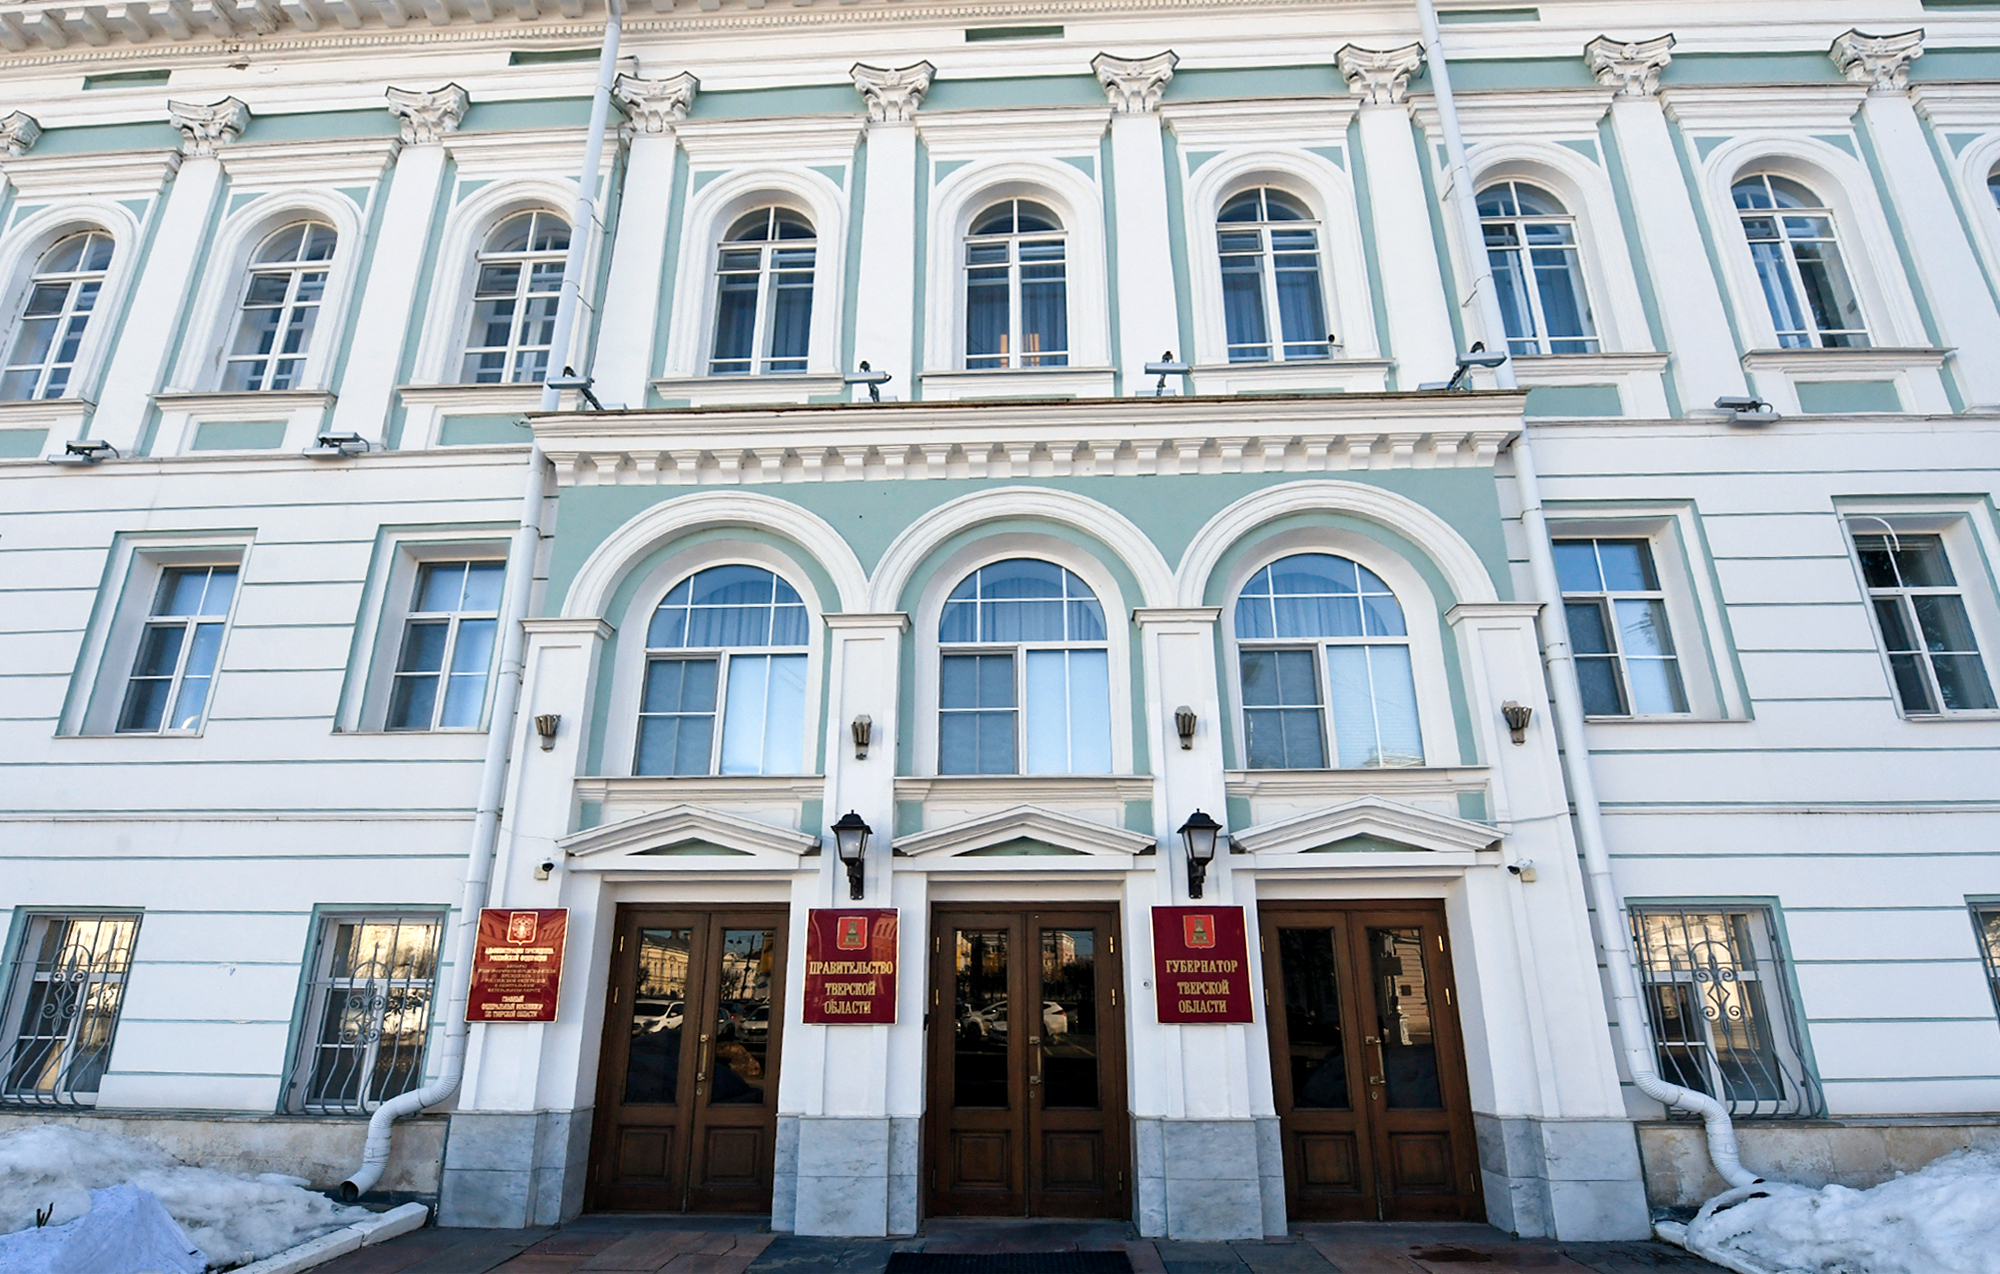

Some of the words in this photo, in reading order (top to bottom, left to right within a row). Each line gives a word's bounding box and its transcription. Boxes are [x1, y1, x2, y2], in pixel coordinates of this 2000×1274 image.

[809, 961, 894, 975] ПРАВИТЕЛЬСТВО
[1165, 960, 1239, 973] ГУБЕРНАТОР
[824, 980, 877, 996] ТВЕРСКОЙ
[1176, 979, 1231, 995] ТВЕРСКОЙ
[824, 1001, 872, 1014] ОБЛАСТИ
[1178, 1000, 1228, 1013] ОБЛАСТИ
